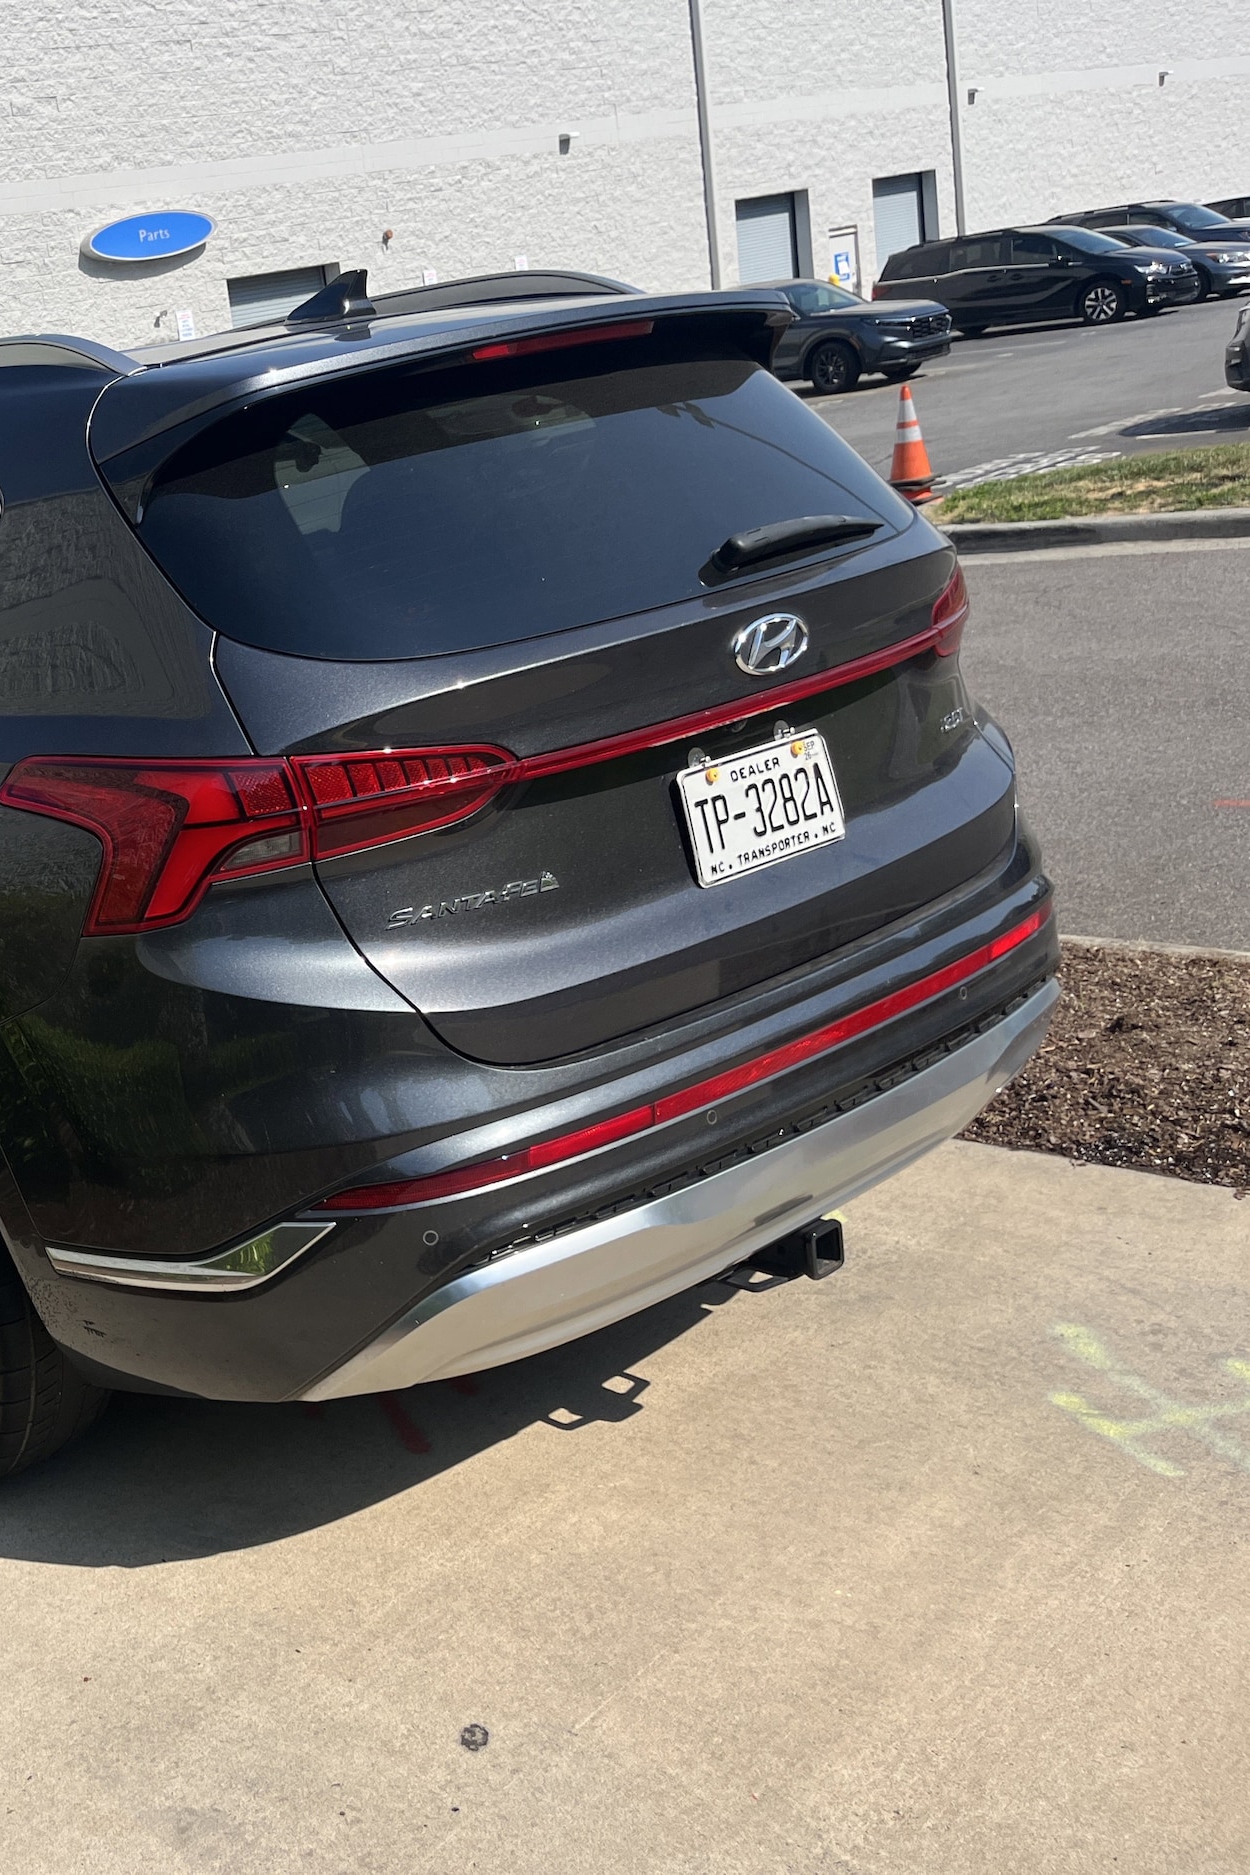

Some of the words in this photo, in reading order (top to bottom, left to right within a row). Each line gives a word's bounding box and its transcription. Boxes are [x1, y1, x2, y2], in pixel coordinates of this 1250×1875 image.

[138, 229, 171, 243] Parts
[730, 757, 780, 782] DEALER
[694, 762, 835, 854] TP-3282A
[711, 861, 725, 876] NC
[737, 832, 811, 867] TRANSPORTER
[822, 822, 836, 836] NC
[386, 890, 497, 931] SANTA
[499, 879, 539, 902] FE
